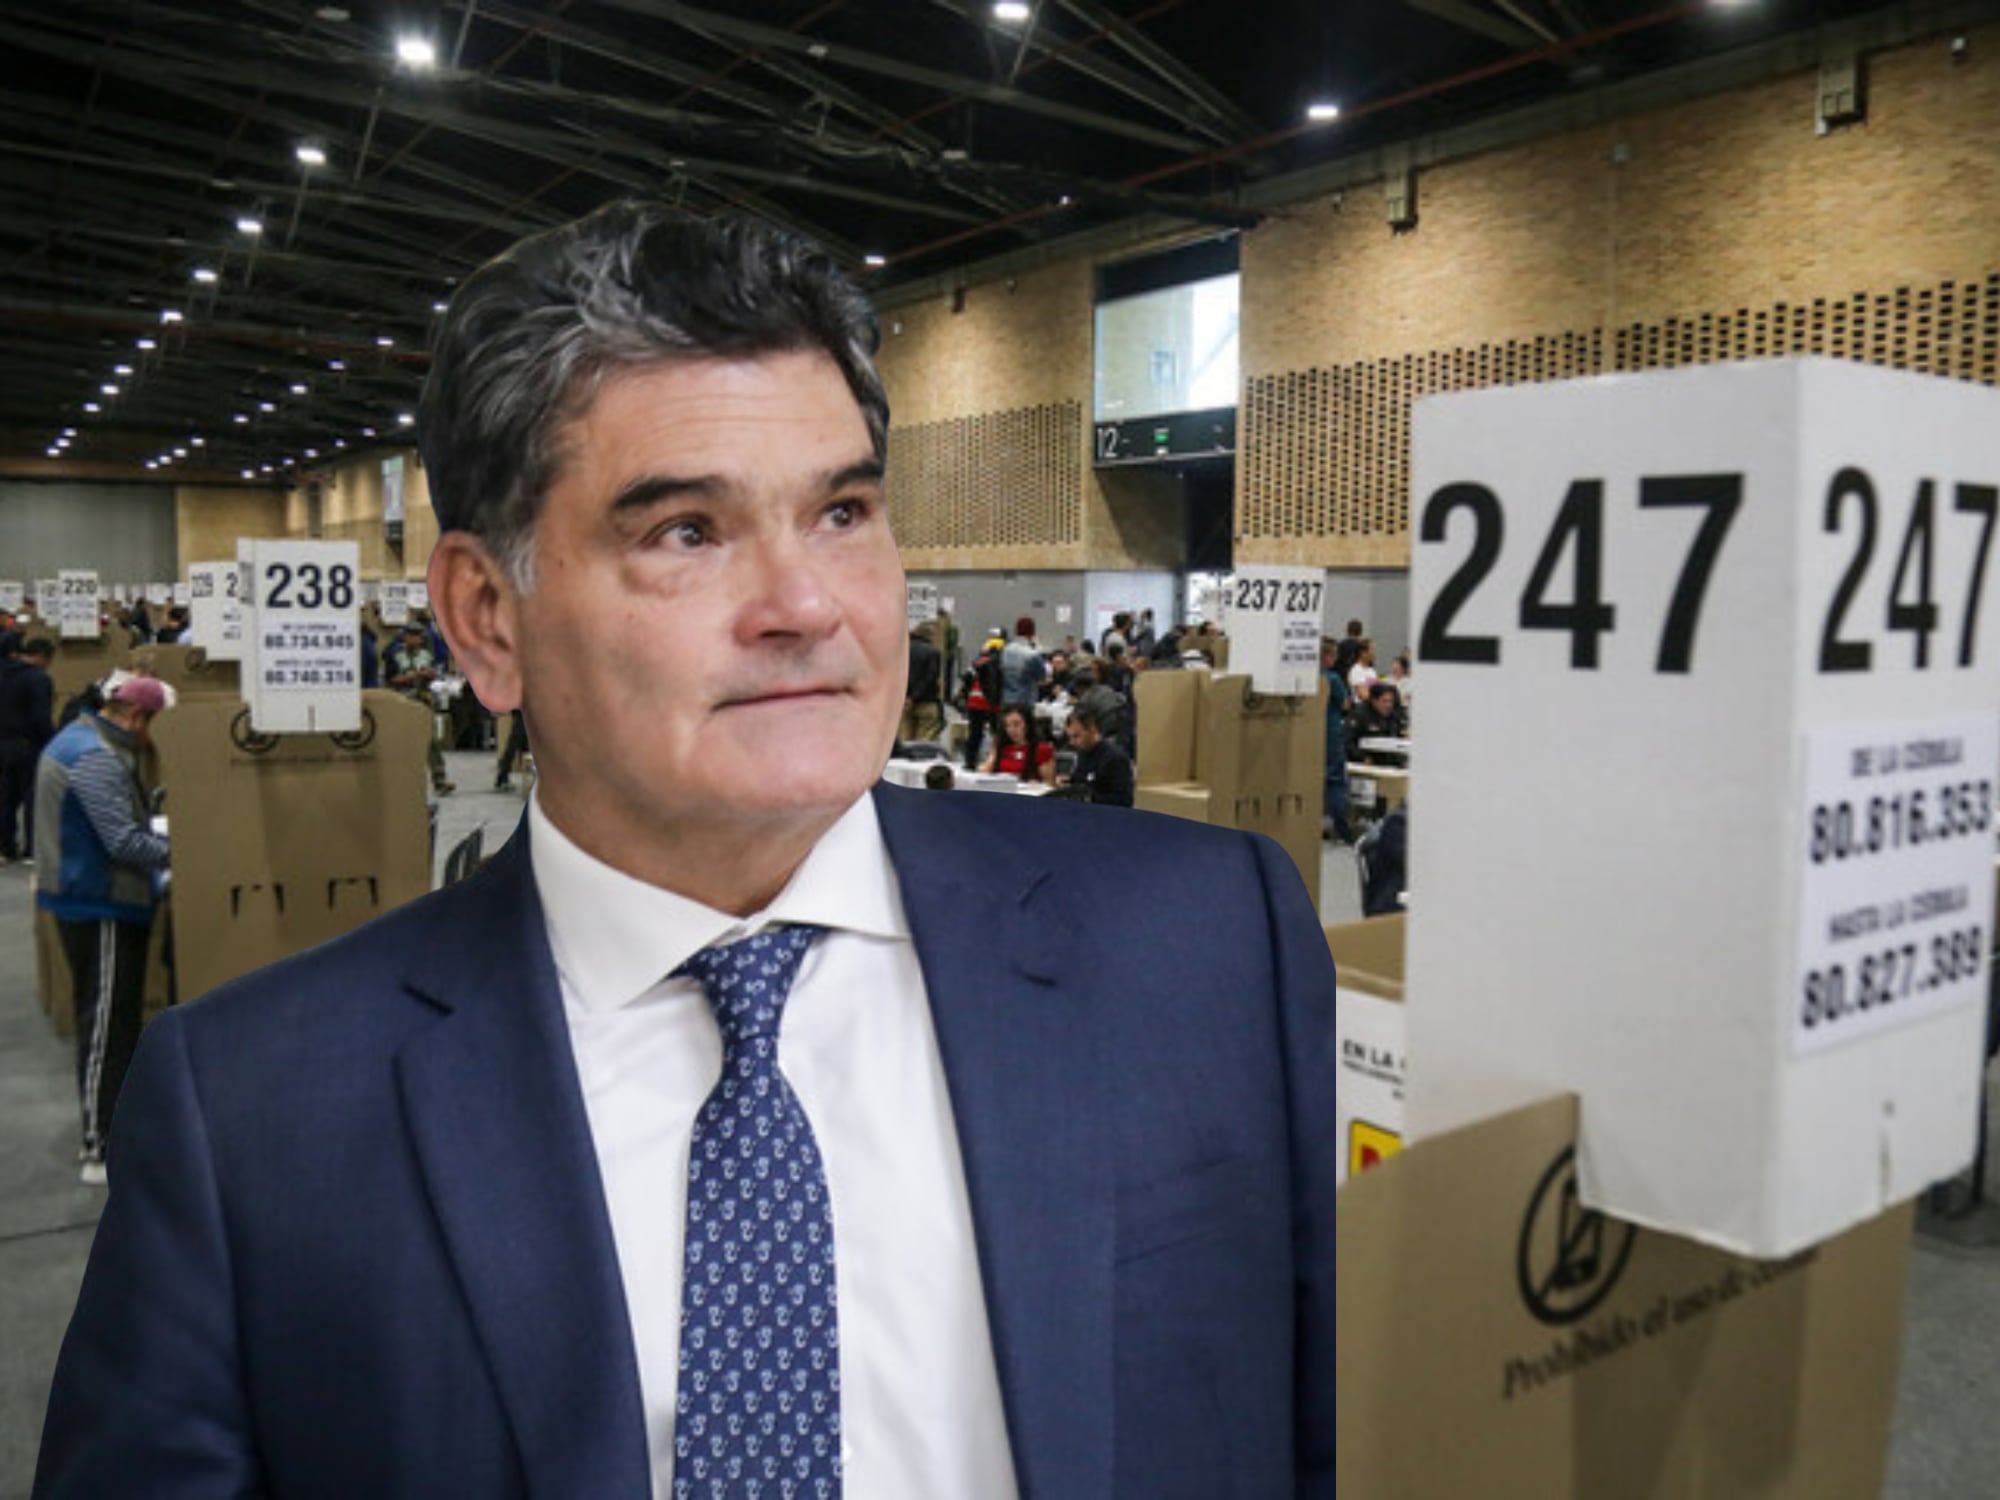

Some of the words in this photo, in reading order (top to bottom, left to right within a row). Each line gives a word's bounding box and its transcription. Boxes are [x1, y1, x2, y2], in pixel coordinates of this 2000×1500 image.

[265, 563, 354, 609] 238
[1236, 579, 1281, 611] 237
[1285, 582, 1322, 612] 237
[1418, 472, 1745, 675] 247
[1818, 466, 2000, 674] 247
[1810, 779, 1992, 865] 80.816.353
[1801, 925, 1981, 1030] 80.827.389
[1343, 1039, 1366, 1061] EN
[1371, 1048, 1394, 1069] LA
